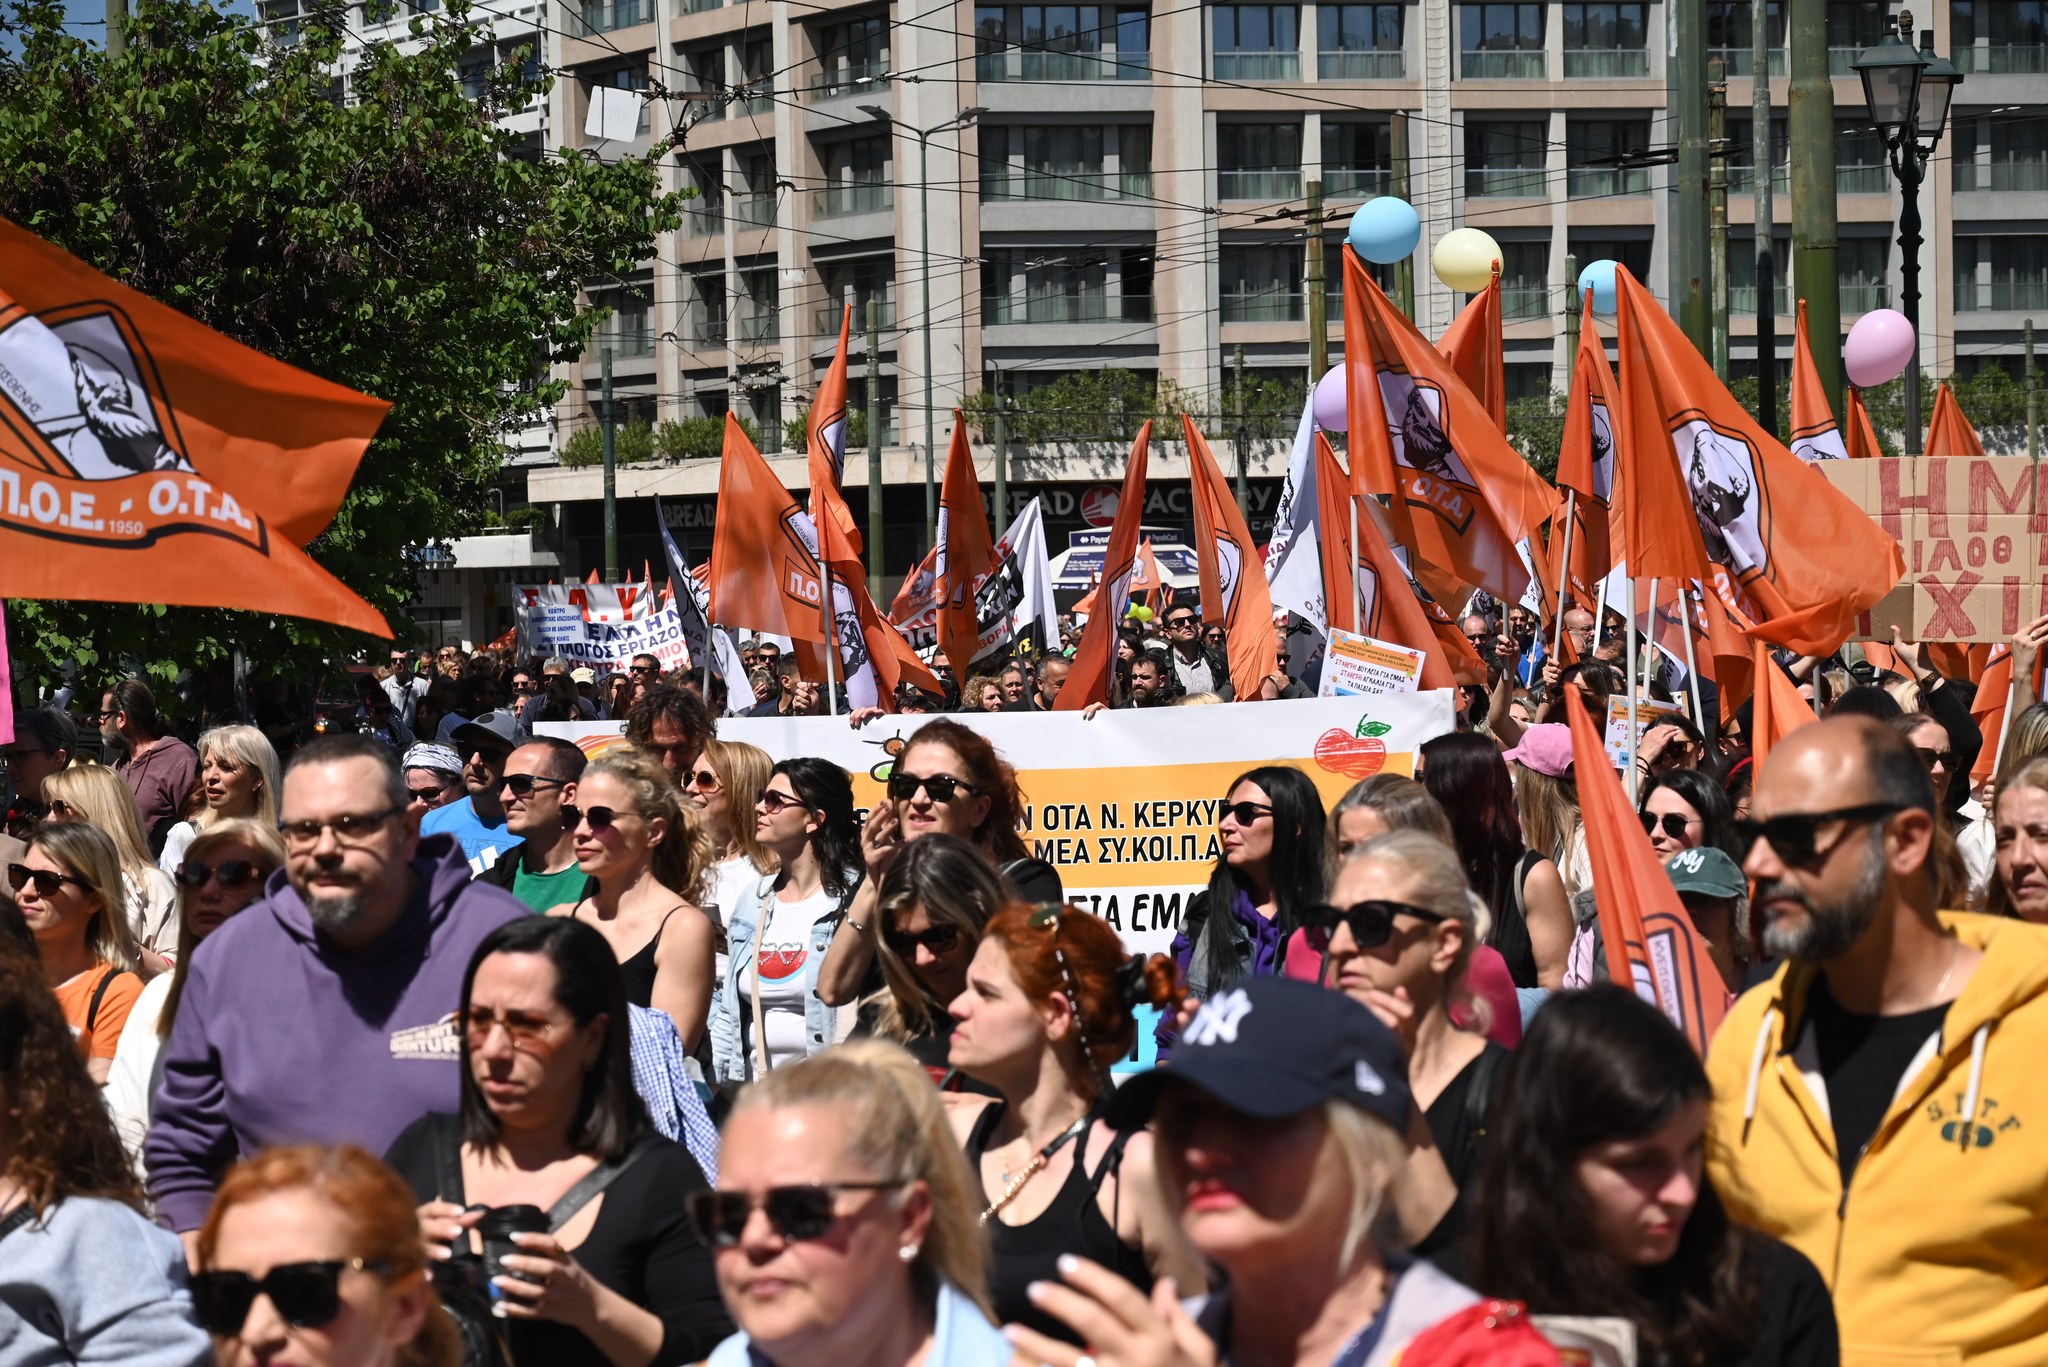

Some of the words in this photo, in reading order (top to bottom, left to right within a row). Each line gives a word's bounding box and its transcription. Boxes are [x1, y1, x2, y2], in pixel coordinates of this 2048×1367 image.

[108, 519, 144, 535] 1950
[662, 503, 716, 529] BREAD
[1043, 805, 1092, 831] ΟΤΑ
[1101, 803, 1125, 830] Ν.
[1035, 838, 1090, 864] ΜΕΑ
[1672, 850, 1704, 874] NY
[1183, 988, 1253, 1046] NY
